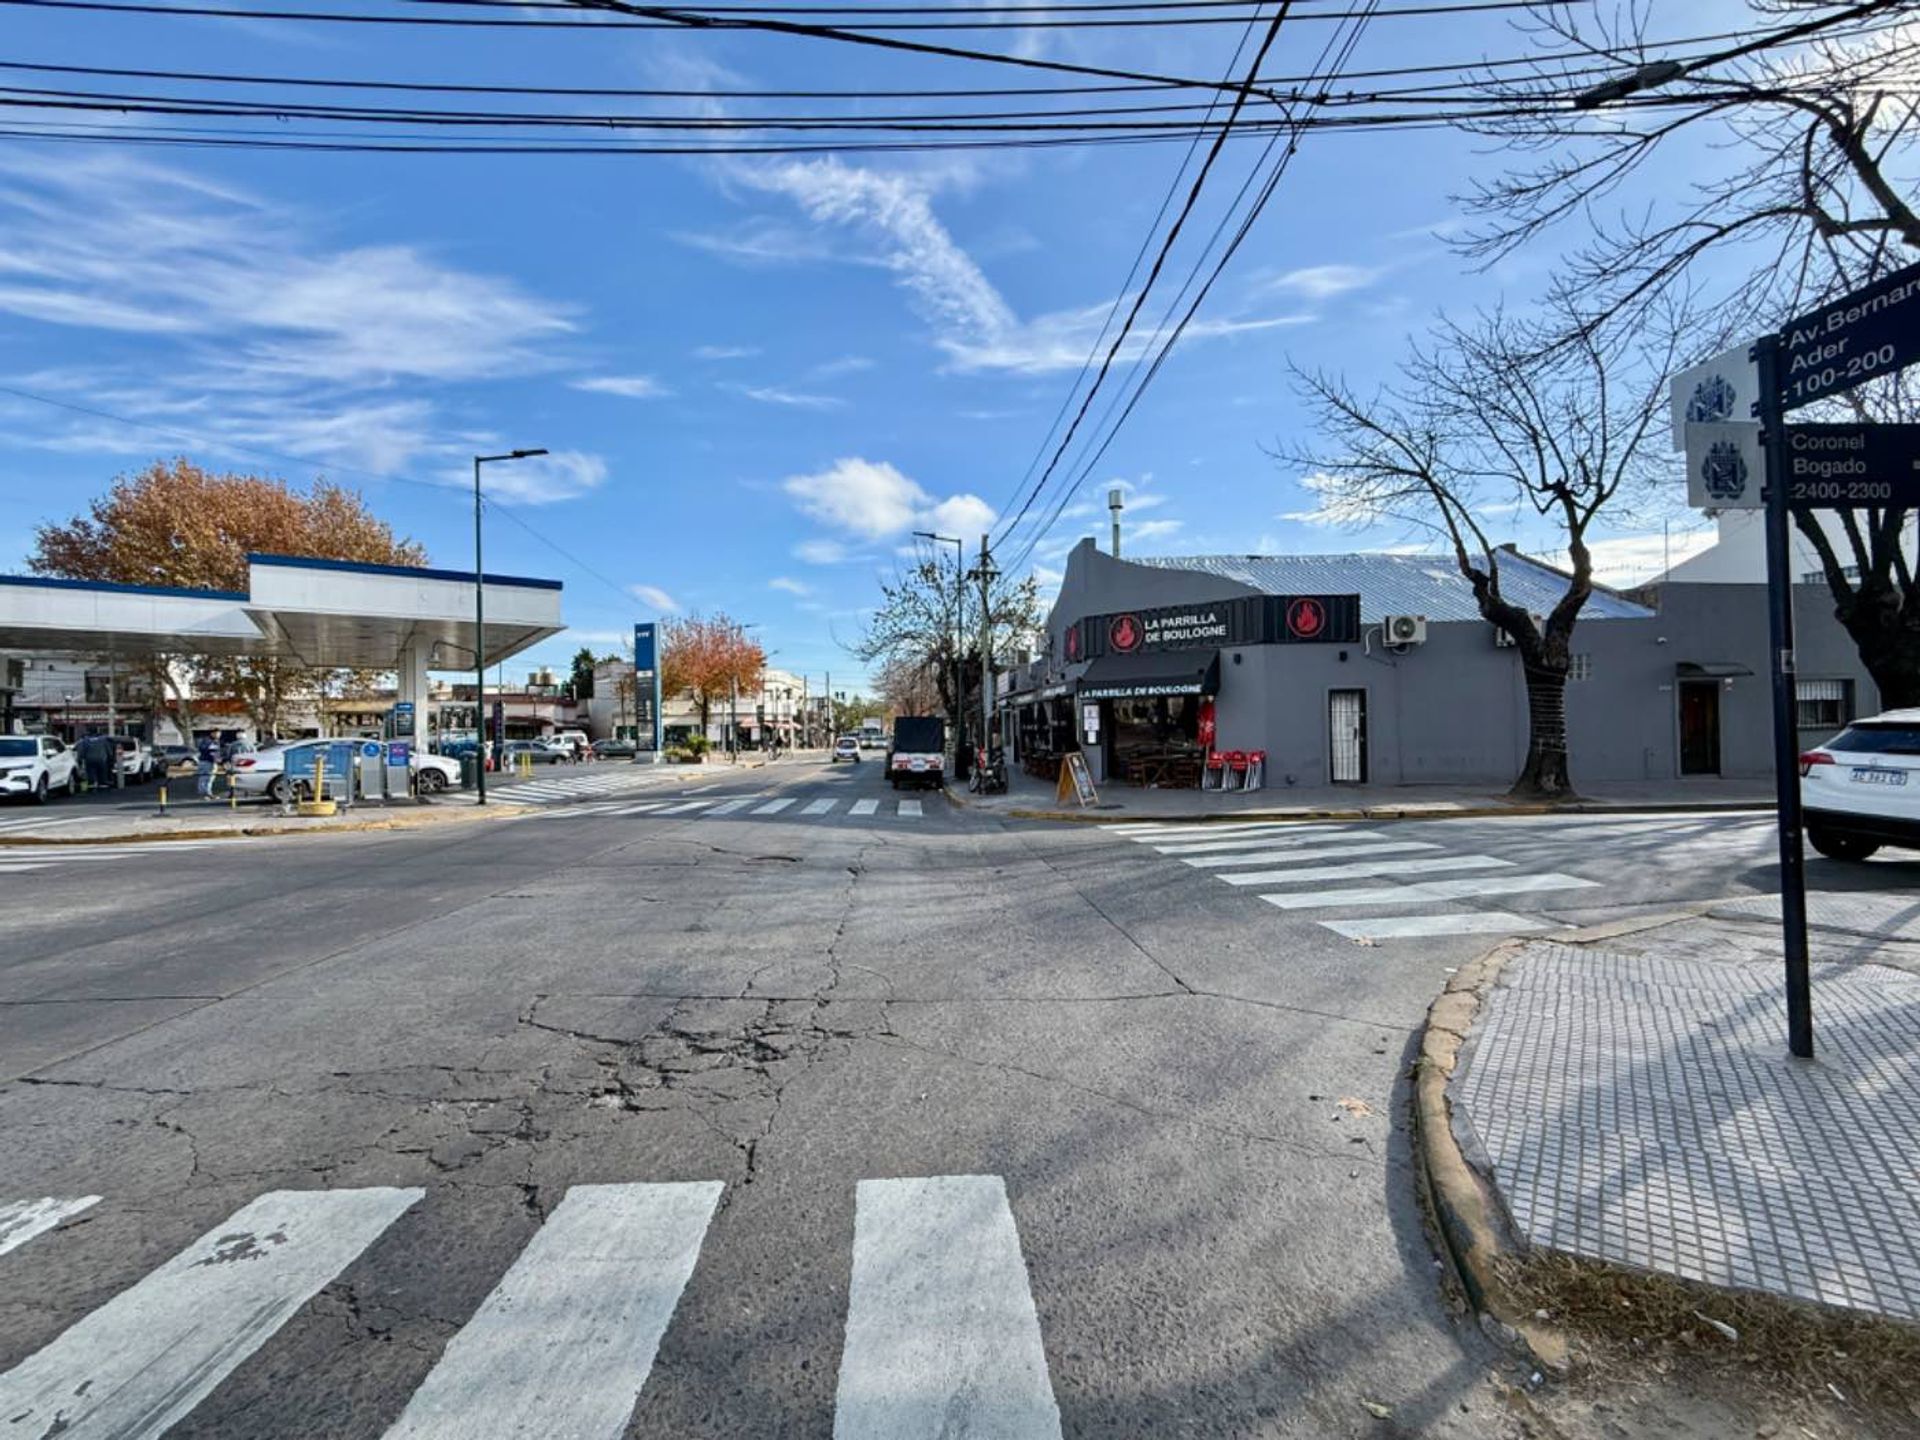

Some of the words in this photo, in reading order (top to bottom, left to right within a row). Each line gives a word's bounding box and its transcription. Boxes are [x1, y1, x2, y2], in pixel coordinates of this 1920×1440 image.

[1789, 279, 1920, 349] Av.Bernar
[1790, 338, 1848, 374] Ader
[1792, 345, 1895, 397] 100-200
[1791, 432, 1865, 451] Coronel
[1793, 457, 1867, 478] Bogado
[1791, 482, 1891, 499] 2400-2300
[1144, 619, 1159, 631] LA
[1160, 612, 1217, 628] PARRILLA
[1145, 632, 1160, 643] DE
[1161, 624, 1227, 641] BOULOGNE
[1079, 689, 1090, 698] LA
[1134, 686, 1146, 696] DE
